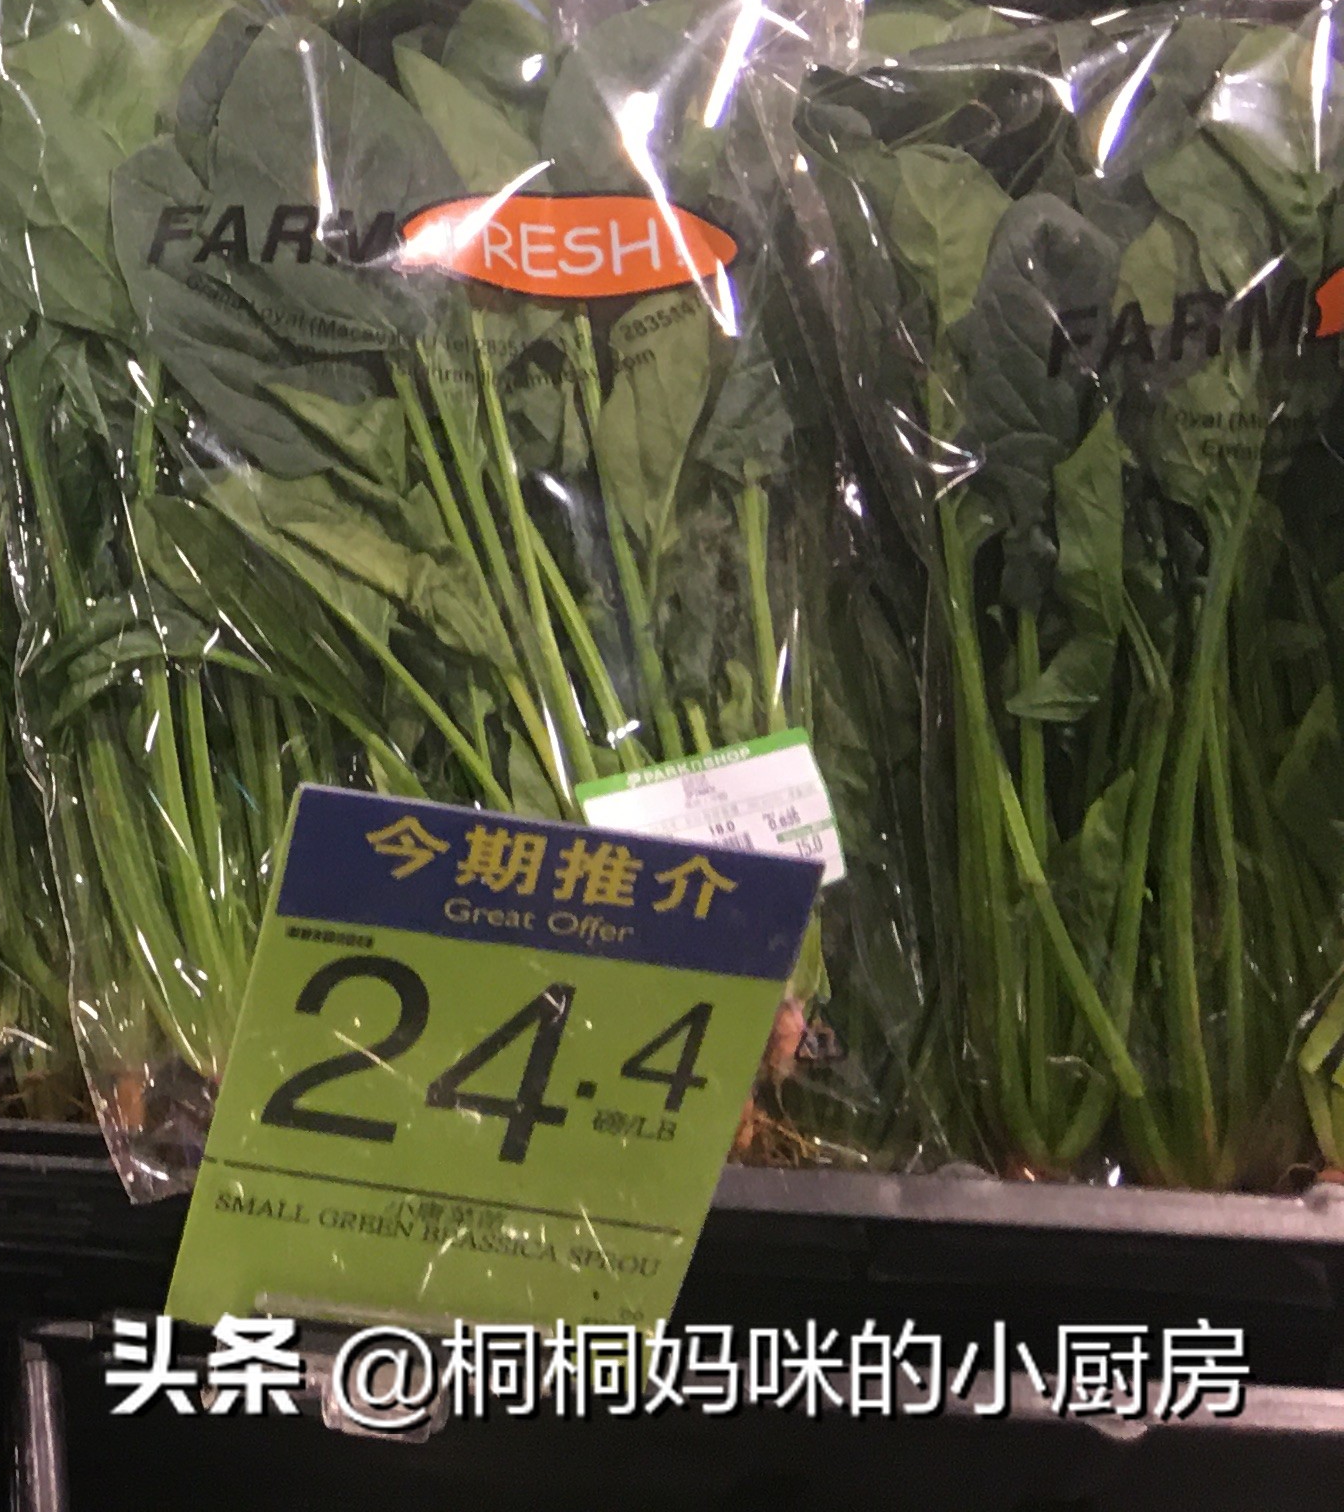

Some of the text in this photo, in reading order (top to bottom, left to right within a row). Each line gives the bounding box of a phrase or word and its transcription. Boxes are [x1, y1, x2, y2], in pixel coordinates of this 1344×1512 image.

[366, 815, 738, 920] 今期推介
[443, 896, 636, 949] Great Offer
[260, 955, 715, 1166] 24.4
[214, 1191, 311, 1225] SMALL
[318, 1207, 413, 1239] GREEN
